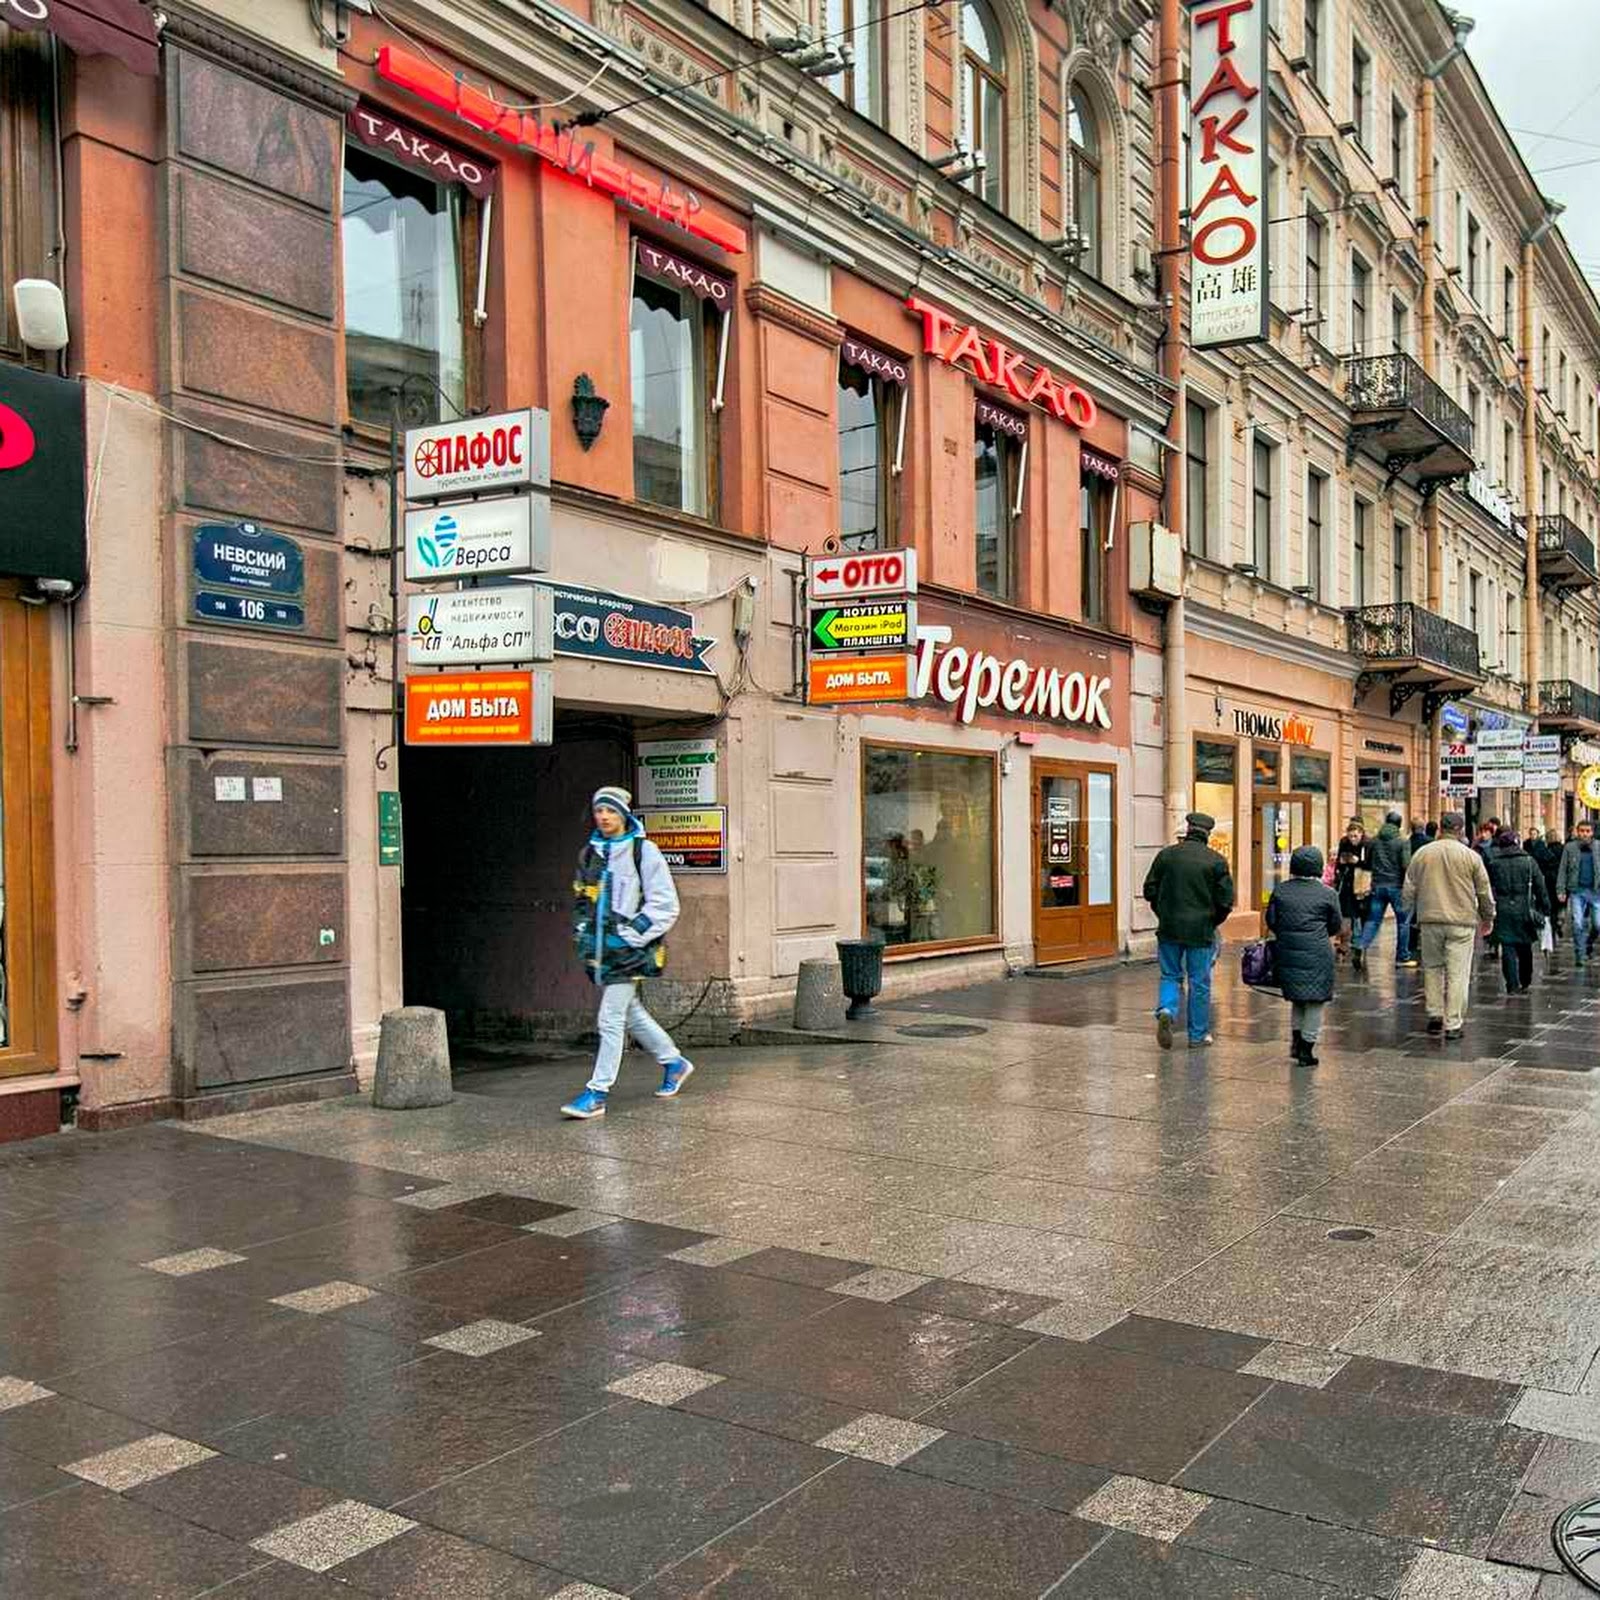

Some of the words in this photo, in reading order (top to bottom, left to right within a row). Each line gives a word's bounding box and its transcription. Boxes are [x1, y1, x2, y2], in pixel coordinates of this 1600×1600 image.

[436, 425, 523, 475] ПАФОС
[213, 542, 286, 571] НЕВСКИЙ
[455, 545, 512, 568] Верса
[231, 563, 270, 577] ПРОСПЕКТ
[239, 599, 265, 620] 106
[451, 597, 502, 608] АГЕНТСТВО
[843, 604, 903, 617] НОУТБУКИ
[451, 611, 525, 623] НЕДВИЖИМОСТИ
[843, 635, 903, 647] ПЛАНШЕТЫ
[826, 674, 854, 688] ДОМ
[857, 671, 892, 686] БЫТА
[915, 625, 1112, 730] Теремок
[427, 699, 466, 721] ДОМ
[470, 697, 519, 717] БЫТА
[1233, 709, 1281, 739] THOMAS
[1449, 745, 1466, 755] 24
[652, 767, 701, 778] РЕМОНТ
